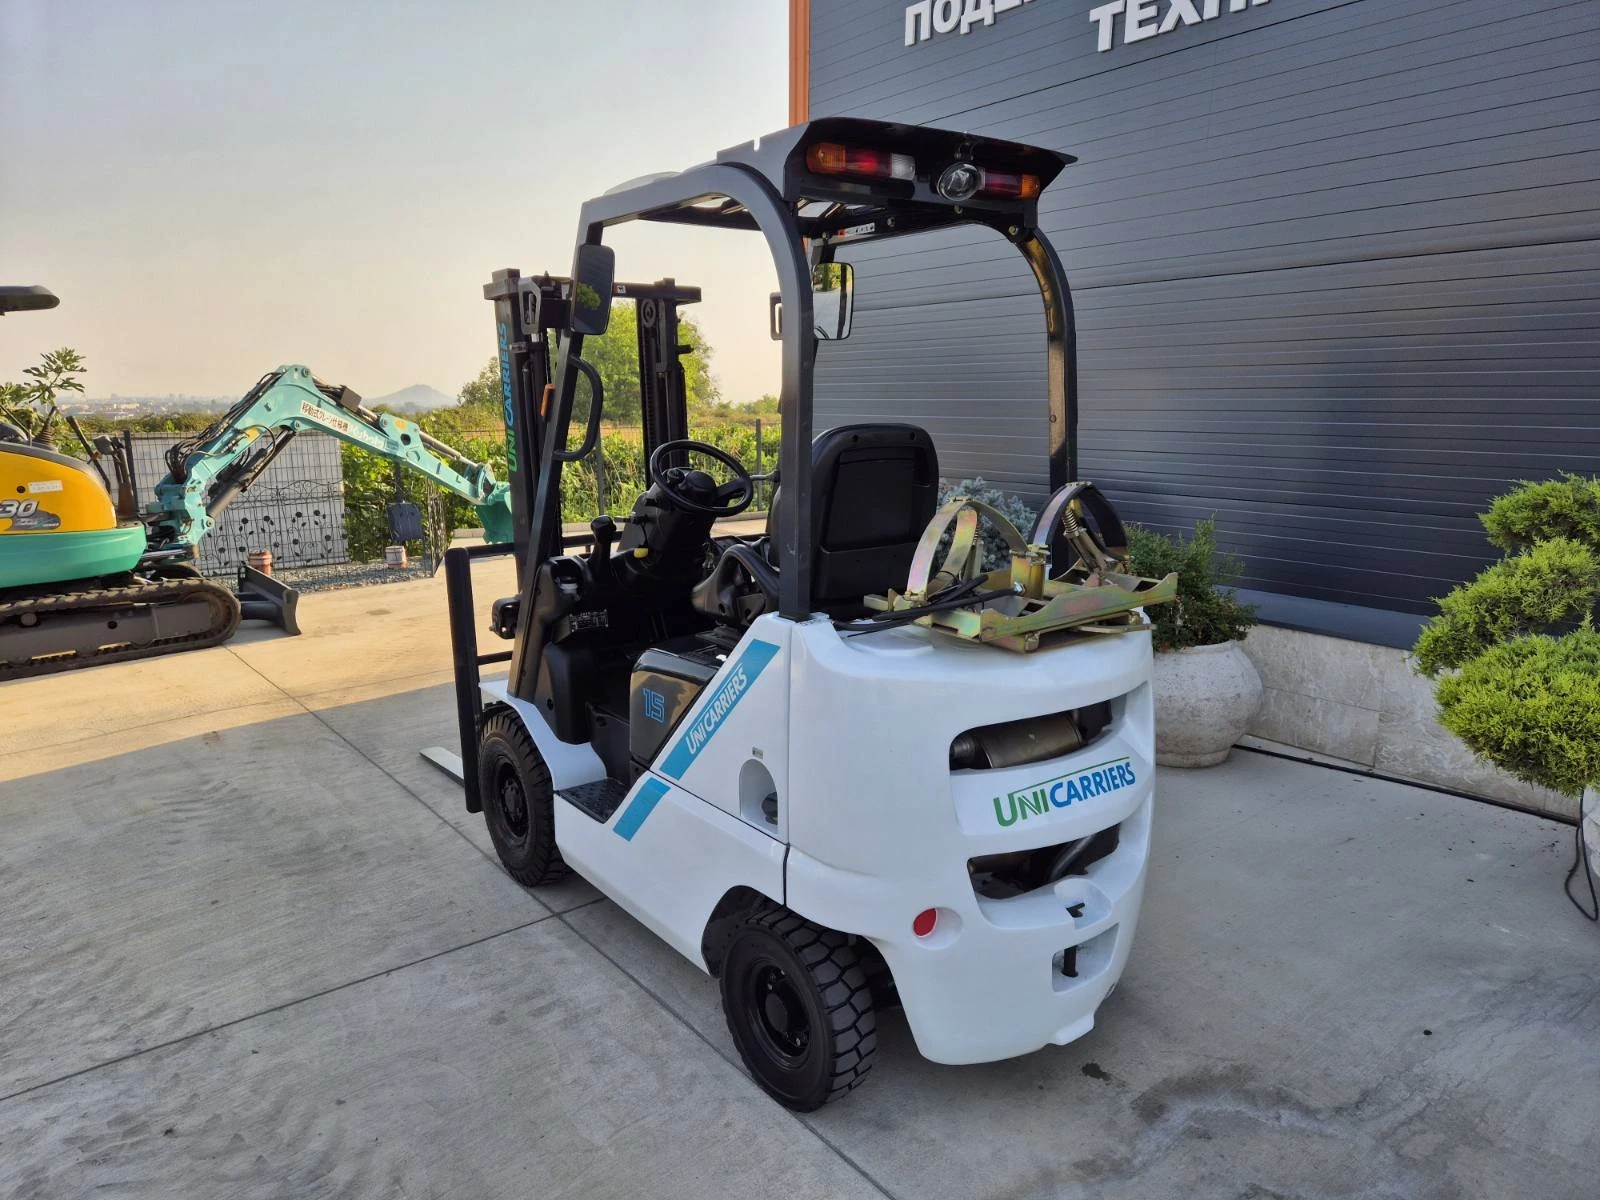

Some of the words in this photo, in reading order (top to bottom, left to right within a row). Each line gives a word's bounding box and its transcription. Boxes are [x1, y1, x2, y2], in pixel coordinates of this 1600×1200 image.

[904, 0, 1034, 47] ПОД
[643, 687, 665, 724] 15
[685, 665, 748, 755] UNICARRIERS
[993, 760, 1136, 827] UNICARRIERS
